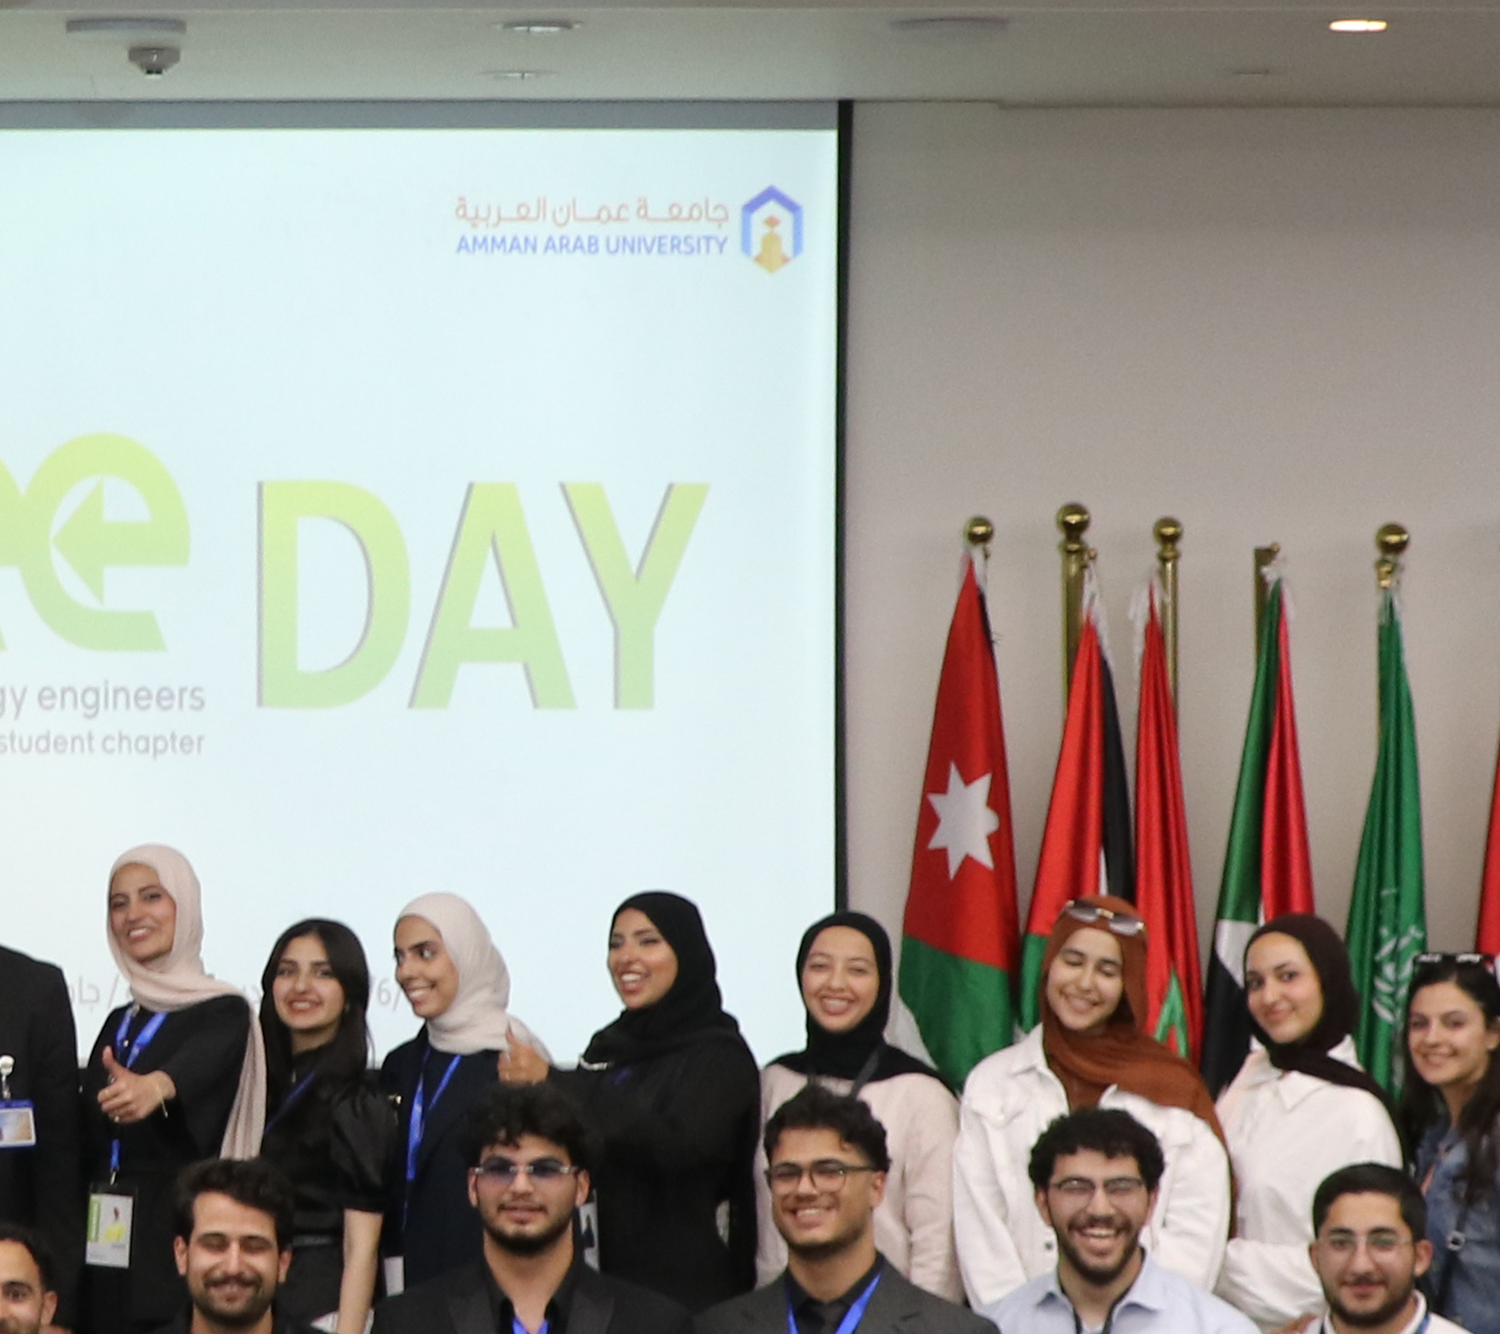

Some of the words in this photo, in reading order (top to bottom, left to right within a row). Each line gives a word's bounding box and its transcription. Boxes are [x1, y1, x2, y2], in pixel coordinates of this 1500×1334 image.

[454, 196, 547, 229] العربية
[552, 196, 630, 227] عمان
[637, 196, 730, 228] جامعة
[456, 235, 538, 255] AMMAN
[543, 235, 600, 255] ARAB
[606, 235, 729, 255] UNIVERSITY
[255, 480, 711, 711] DAY
[36, 679, 206, 720] engineers
[101, 729, 205, 761] chapter
